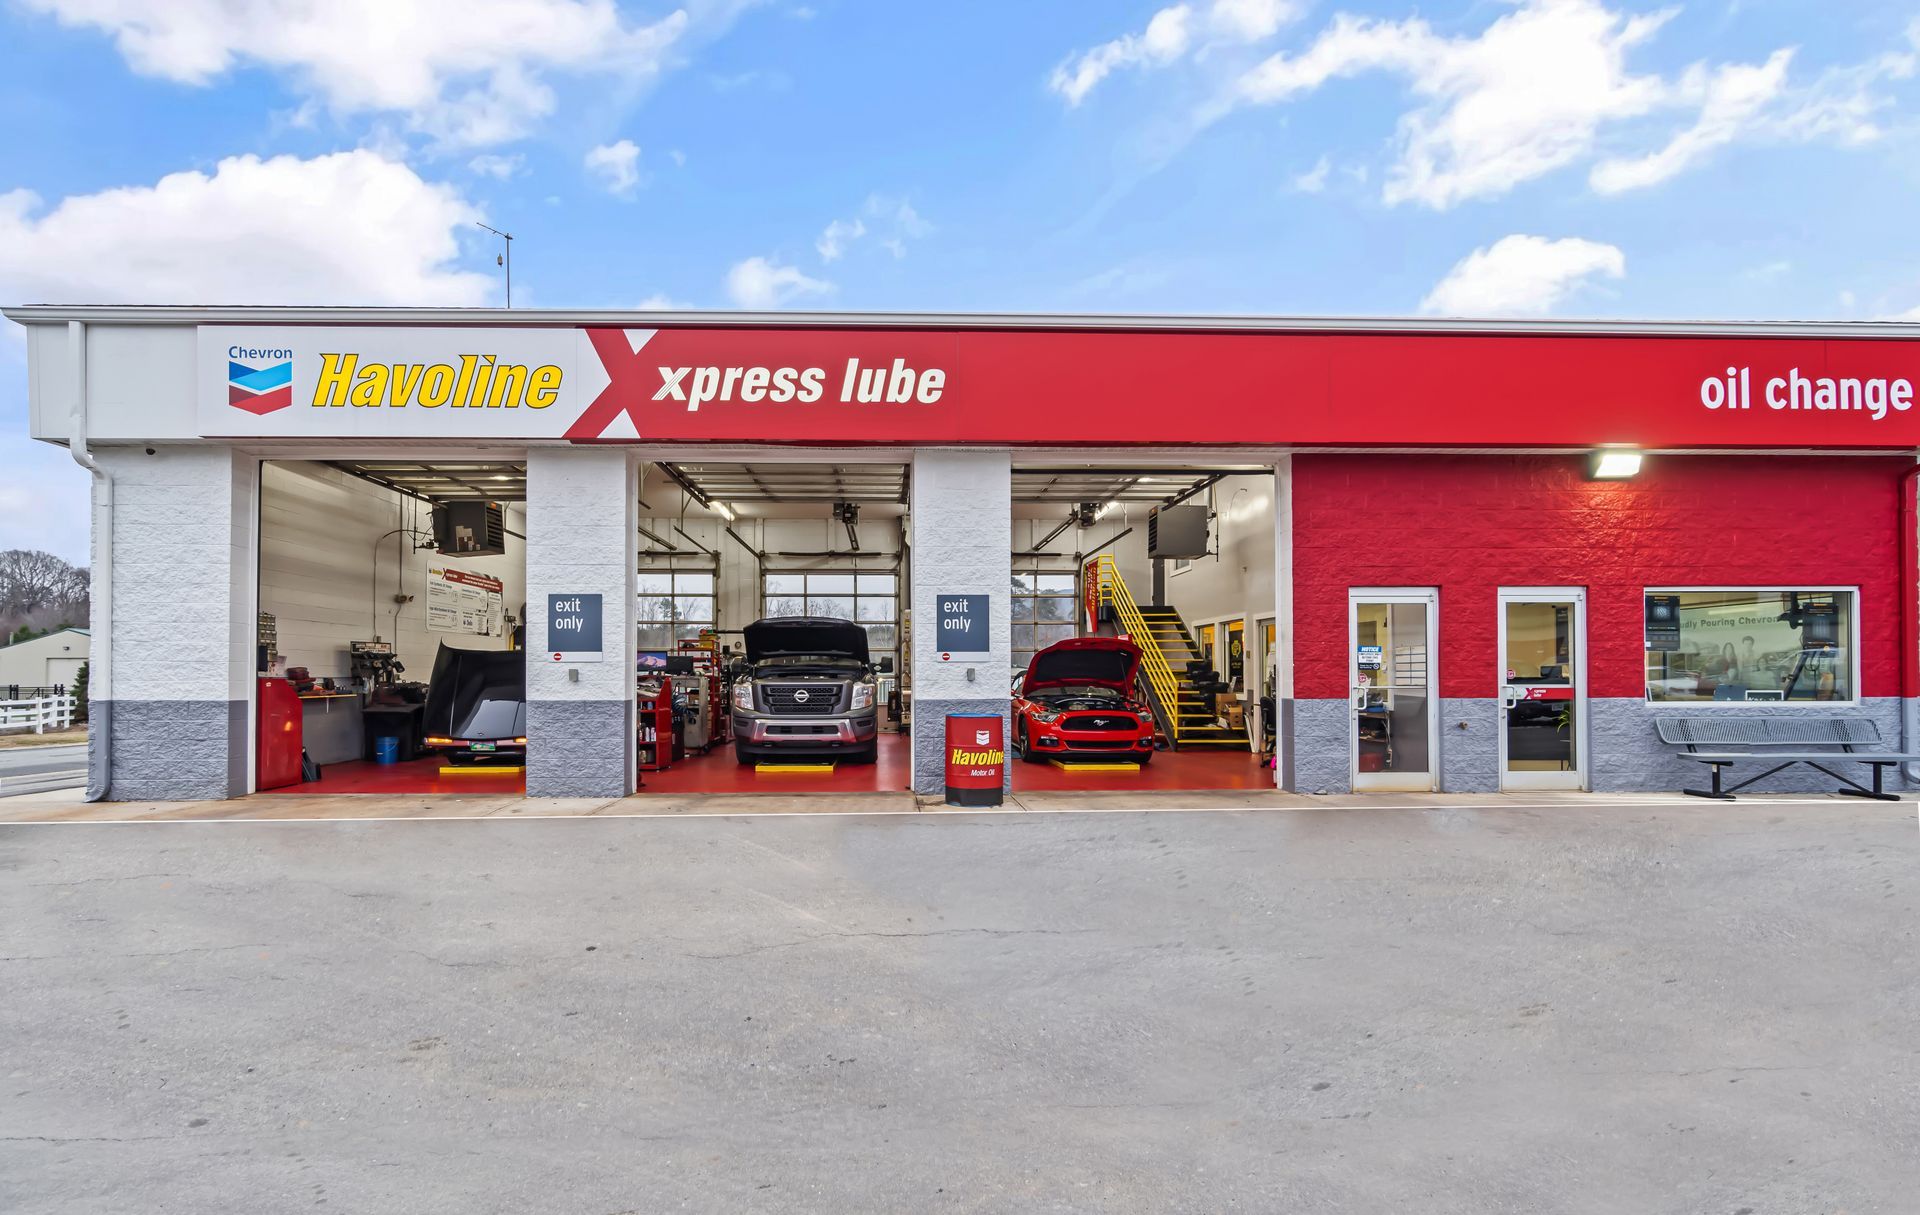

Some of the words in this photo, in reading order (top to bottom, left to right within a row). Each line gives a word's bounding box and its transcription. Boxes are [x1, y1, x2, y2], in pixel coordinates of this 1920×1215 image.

[228, 345, 293, 359] Chevron
[311, 352, 564, 410] Havoline
[651, 366, 826, 412] xpress
[839, 357, 946, 404] lube
[1700, 366, 1750, 410] oil
[1765, 367, 1914, 421] change
[555, 598, 581, 612] exit
[944, 599, 969, 612] exit
[555, 615, 584, 633] only
[944, 615, 971, 633] only
[1680, 620, 1697, 629] udly
[1700, 617, 1735, 627] Pouring
[970, 768, 988, 777] Motor
[988, 768, 996, 777] Oil
